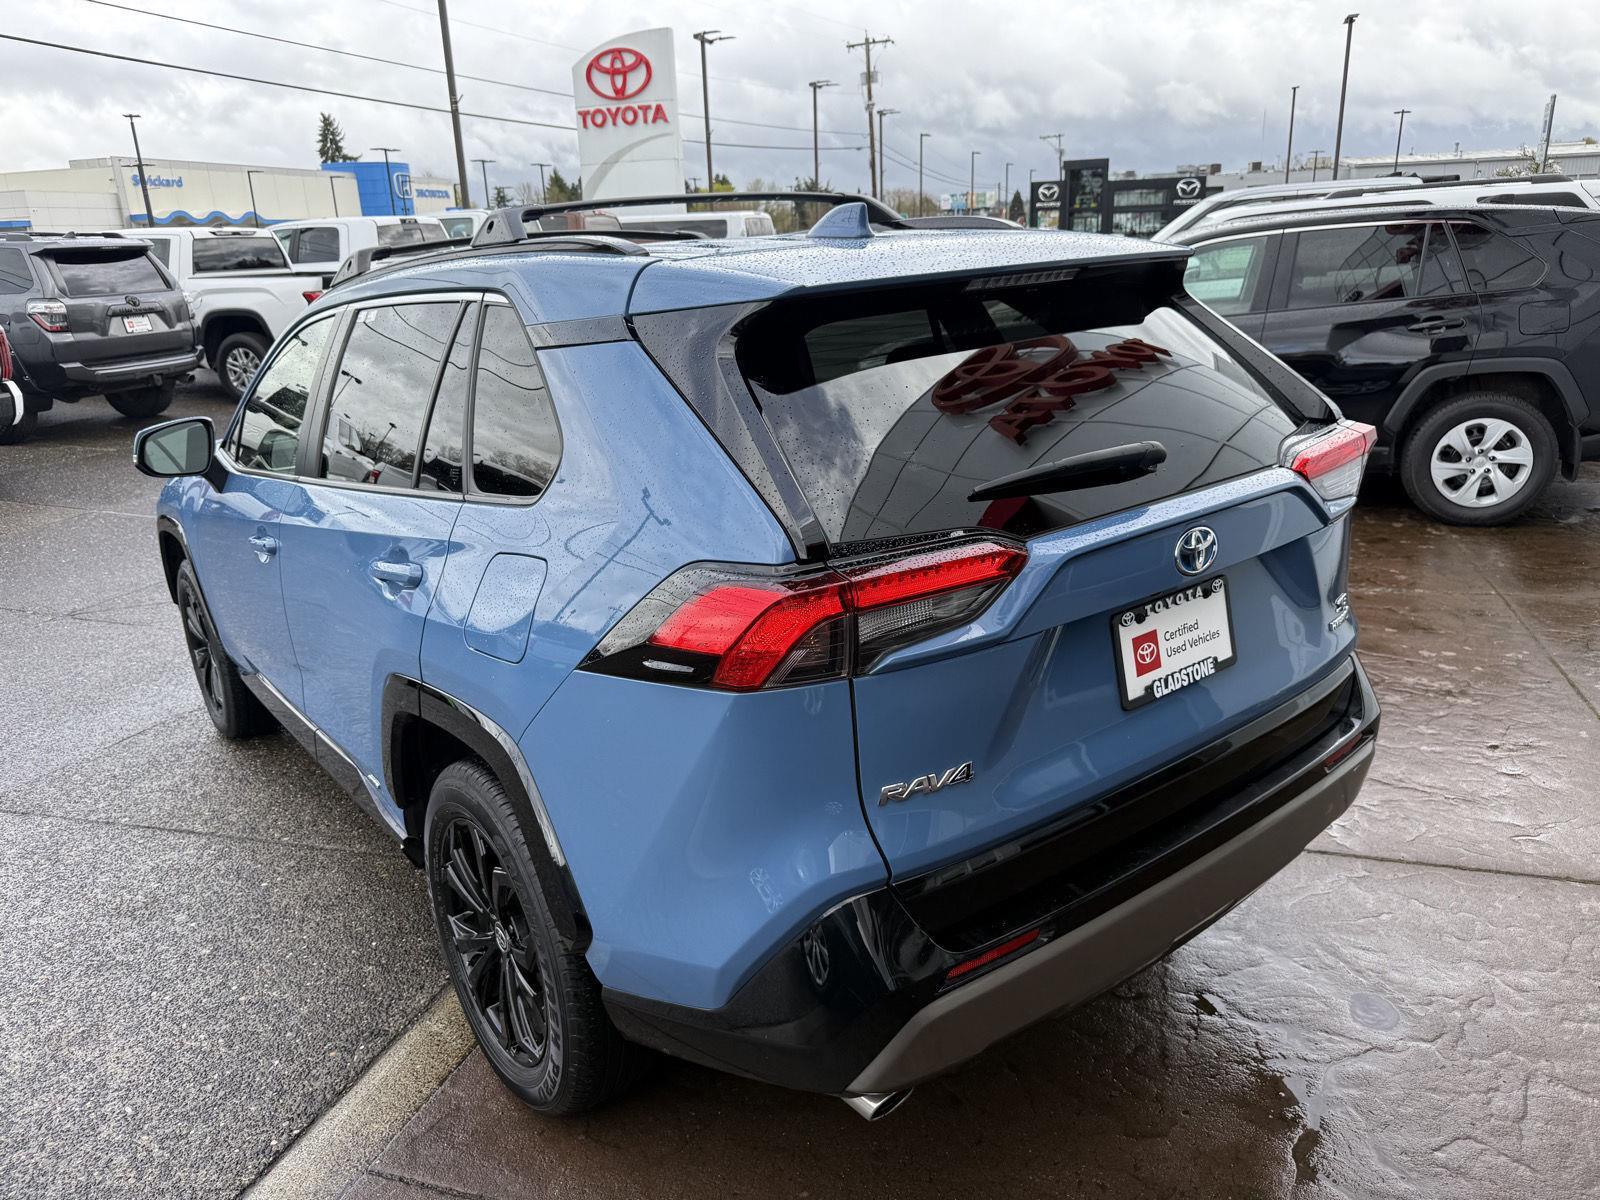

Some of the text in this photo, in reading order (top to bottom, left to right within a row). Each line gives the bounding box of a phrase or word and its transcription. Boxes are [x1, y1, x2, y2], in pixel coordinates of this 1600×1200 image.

[578, 104, 670, 129] TOYOTA
[1144, 586, 1204, 617] TOYOTA
[1163, 619, 1200, 642] Certified
[1165, 629, 1221, 658] Used Vehicles
[1153, 657, 1217, 698] GLADSTONE
[877, 760, 975, 806] RAV4
